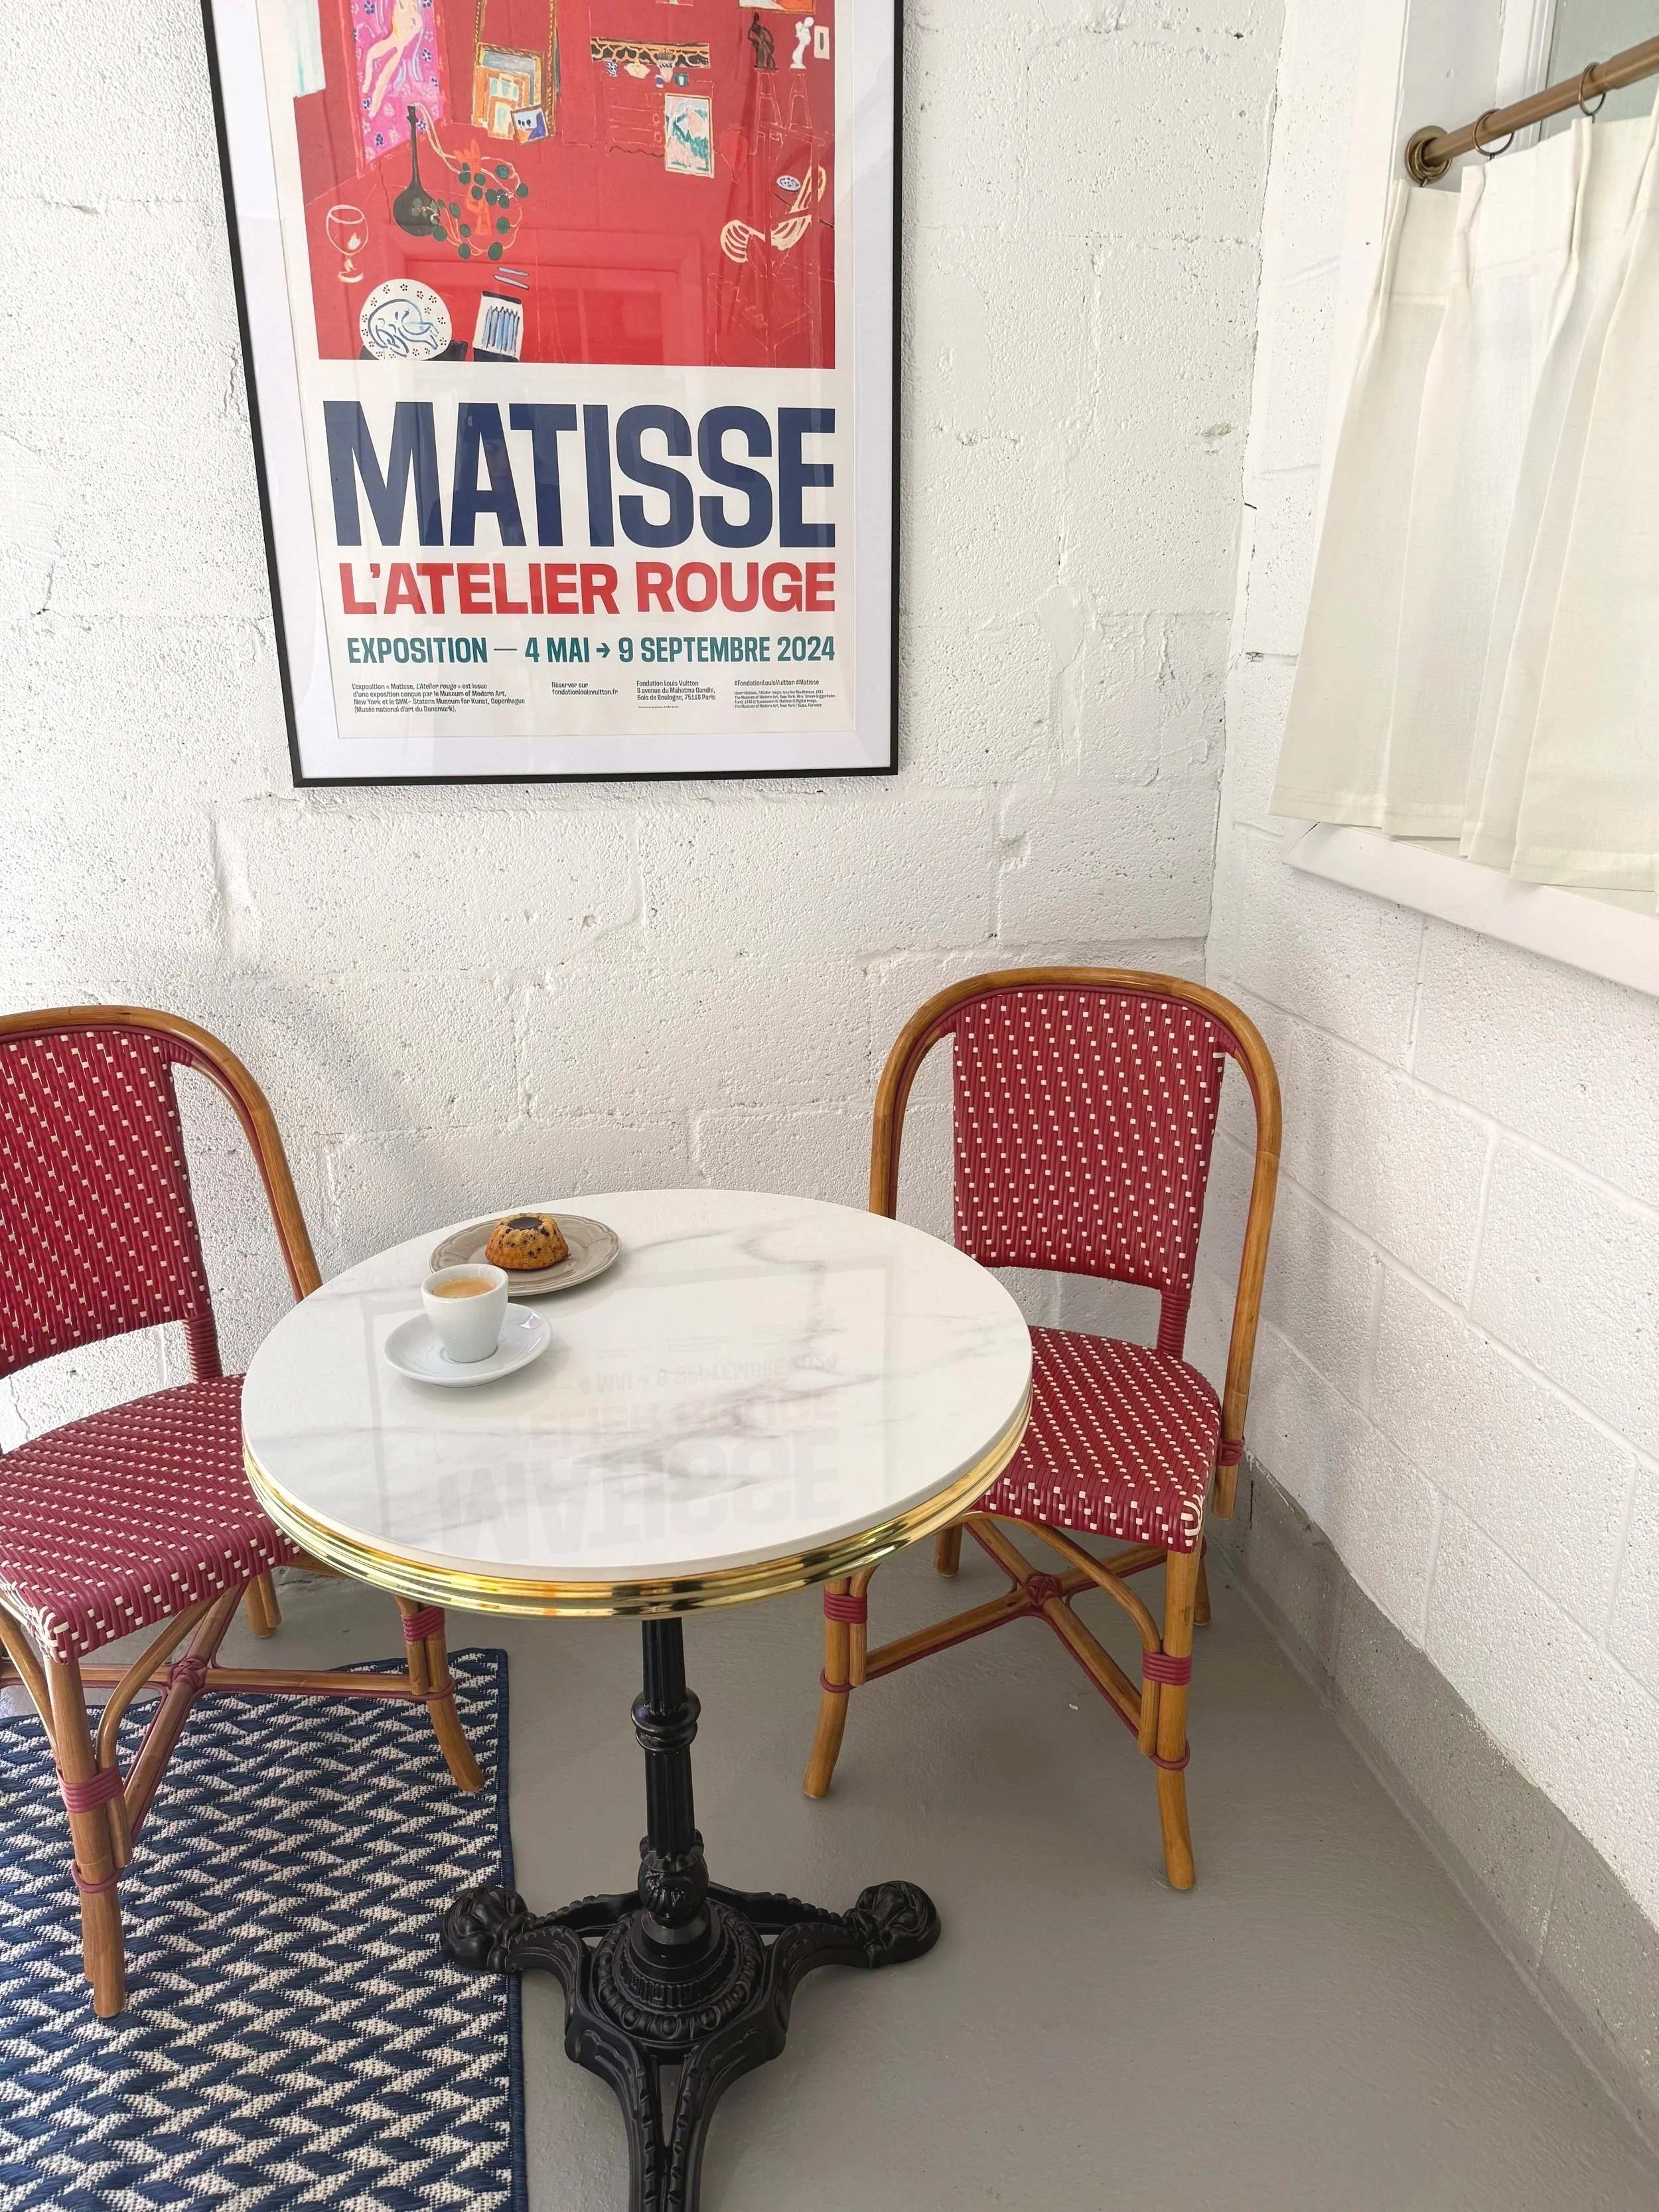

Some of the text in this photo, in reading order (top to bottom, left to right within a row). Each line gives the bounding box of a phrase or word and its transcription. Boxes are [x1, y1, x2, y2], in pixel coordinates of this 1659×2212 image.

[323, 400, 835, 549] MATISSE
[339, 561, 835, 615] L'ATELIER ROUGE
[347, 637, 487, 664] EXPOSITION
[525, 637, 540, 663] 4
[547, 637, 589, 663] MAI
[618, 636, 633, 662] 9
[641, 636, 770, 662] SEPTEMBRE
[776, 636, 835, 662] 2024
